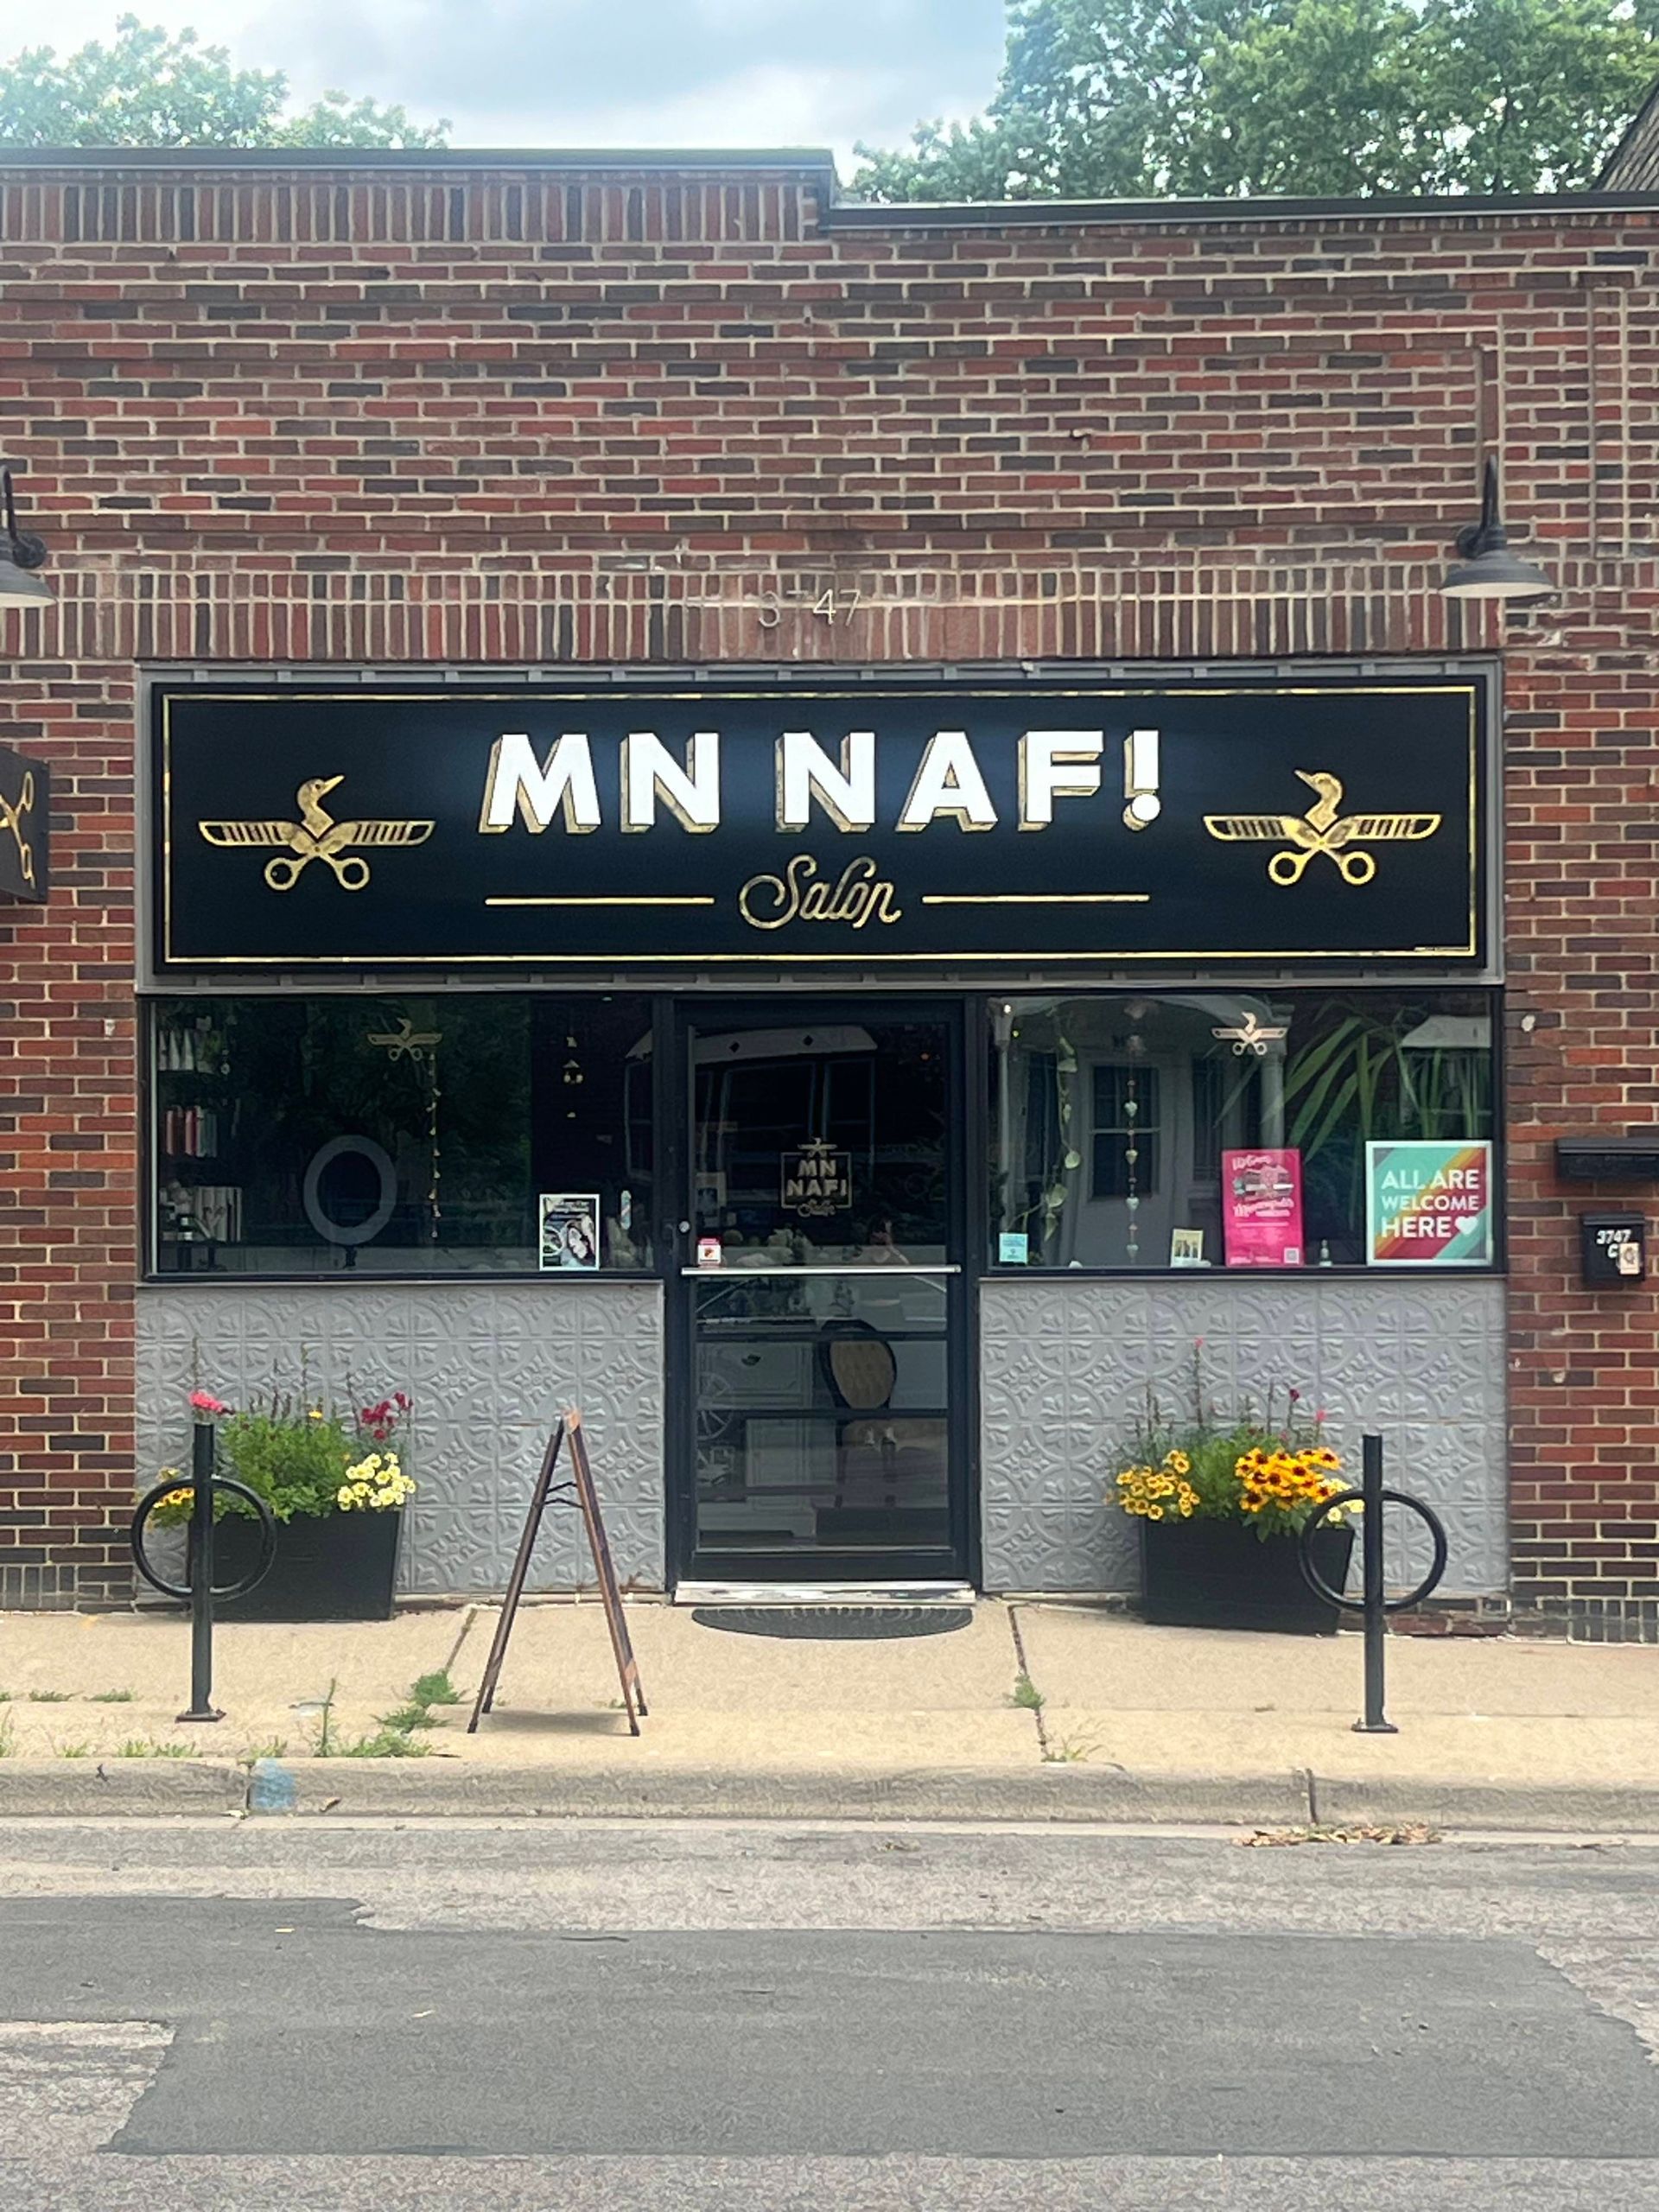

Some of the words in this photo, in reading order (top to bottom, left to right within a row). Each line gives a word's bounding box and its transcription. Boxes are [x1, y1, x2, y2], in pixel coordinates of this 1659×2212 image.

[479, 732, 721, 834] MN
[775, 730, 1161, 833] NAF!
[738, 853, 903, 930] Salon
[798, 1159, 836, 1178] MN
[1381, 1169, 1426, 1191] ALL
[1429, 1168, 1480, 1190] ARE
[1381, 1194, 1480, 1211] WELCOME
[1381, 1216, 1452, 1238] HERE
[1597, 1230, 1631, 1244] 3747
